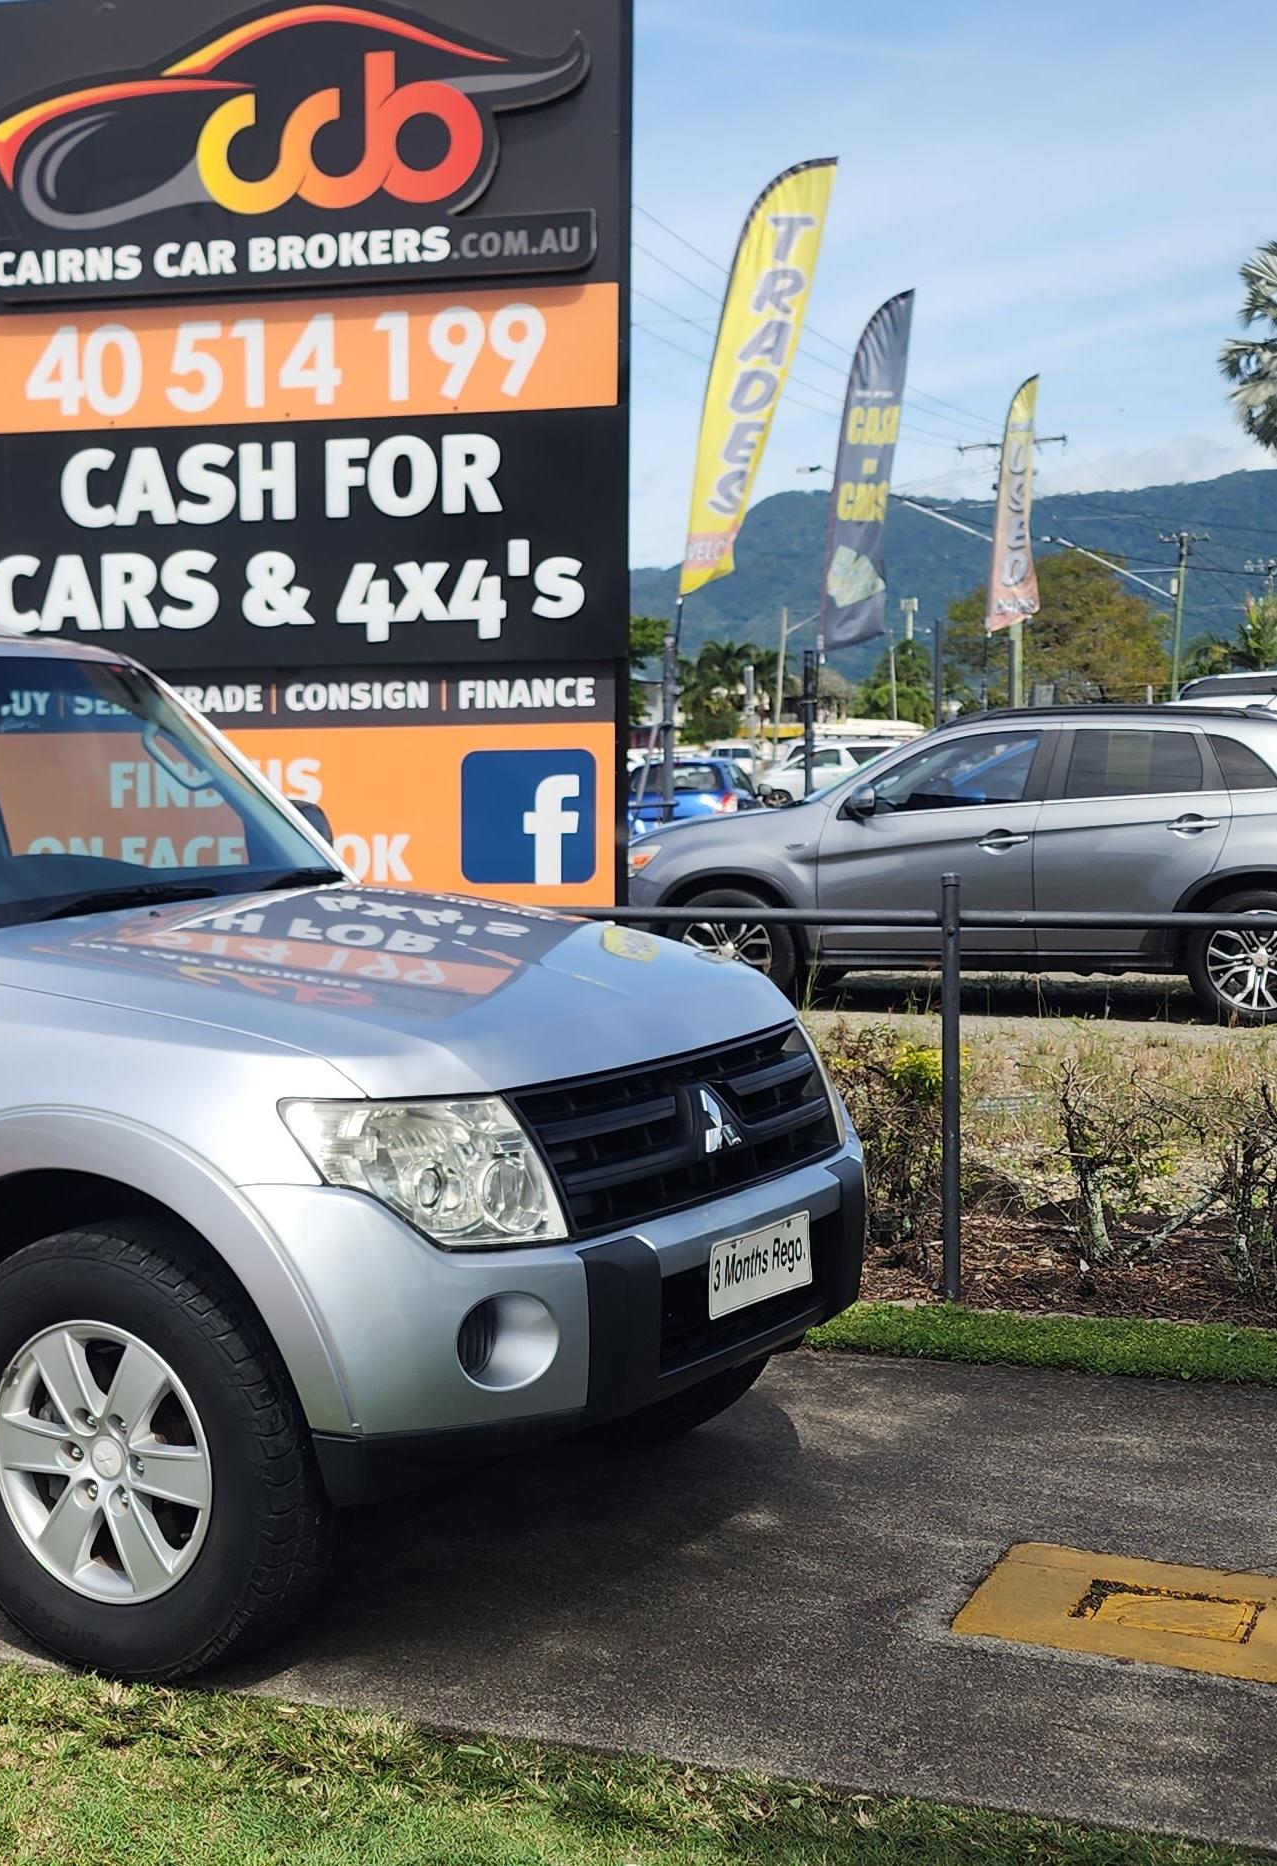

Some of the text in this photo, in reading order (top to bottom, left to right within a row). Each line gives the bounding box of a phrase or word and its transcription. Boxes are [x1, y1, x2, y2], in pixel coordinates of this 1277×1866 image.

[153, 237, 236, 279] CAR
[26, 302, 547, 416] 40 514 199
[708, 216, 816, 517] TRADES
[61, 433, 503, 529] CASH FOR
[241, 550, 316, 628] &
[0, 690, 50, 717] UY
[174, 684, 264, 713] RADE
[284, 680, 429, 711] CONSIGN
[459, 676, 596, 709] FINANCE
[712, 1258, 722, 1292] 3
[724, 1244, 769, 1290] Months
